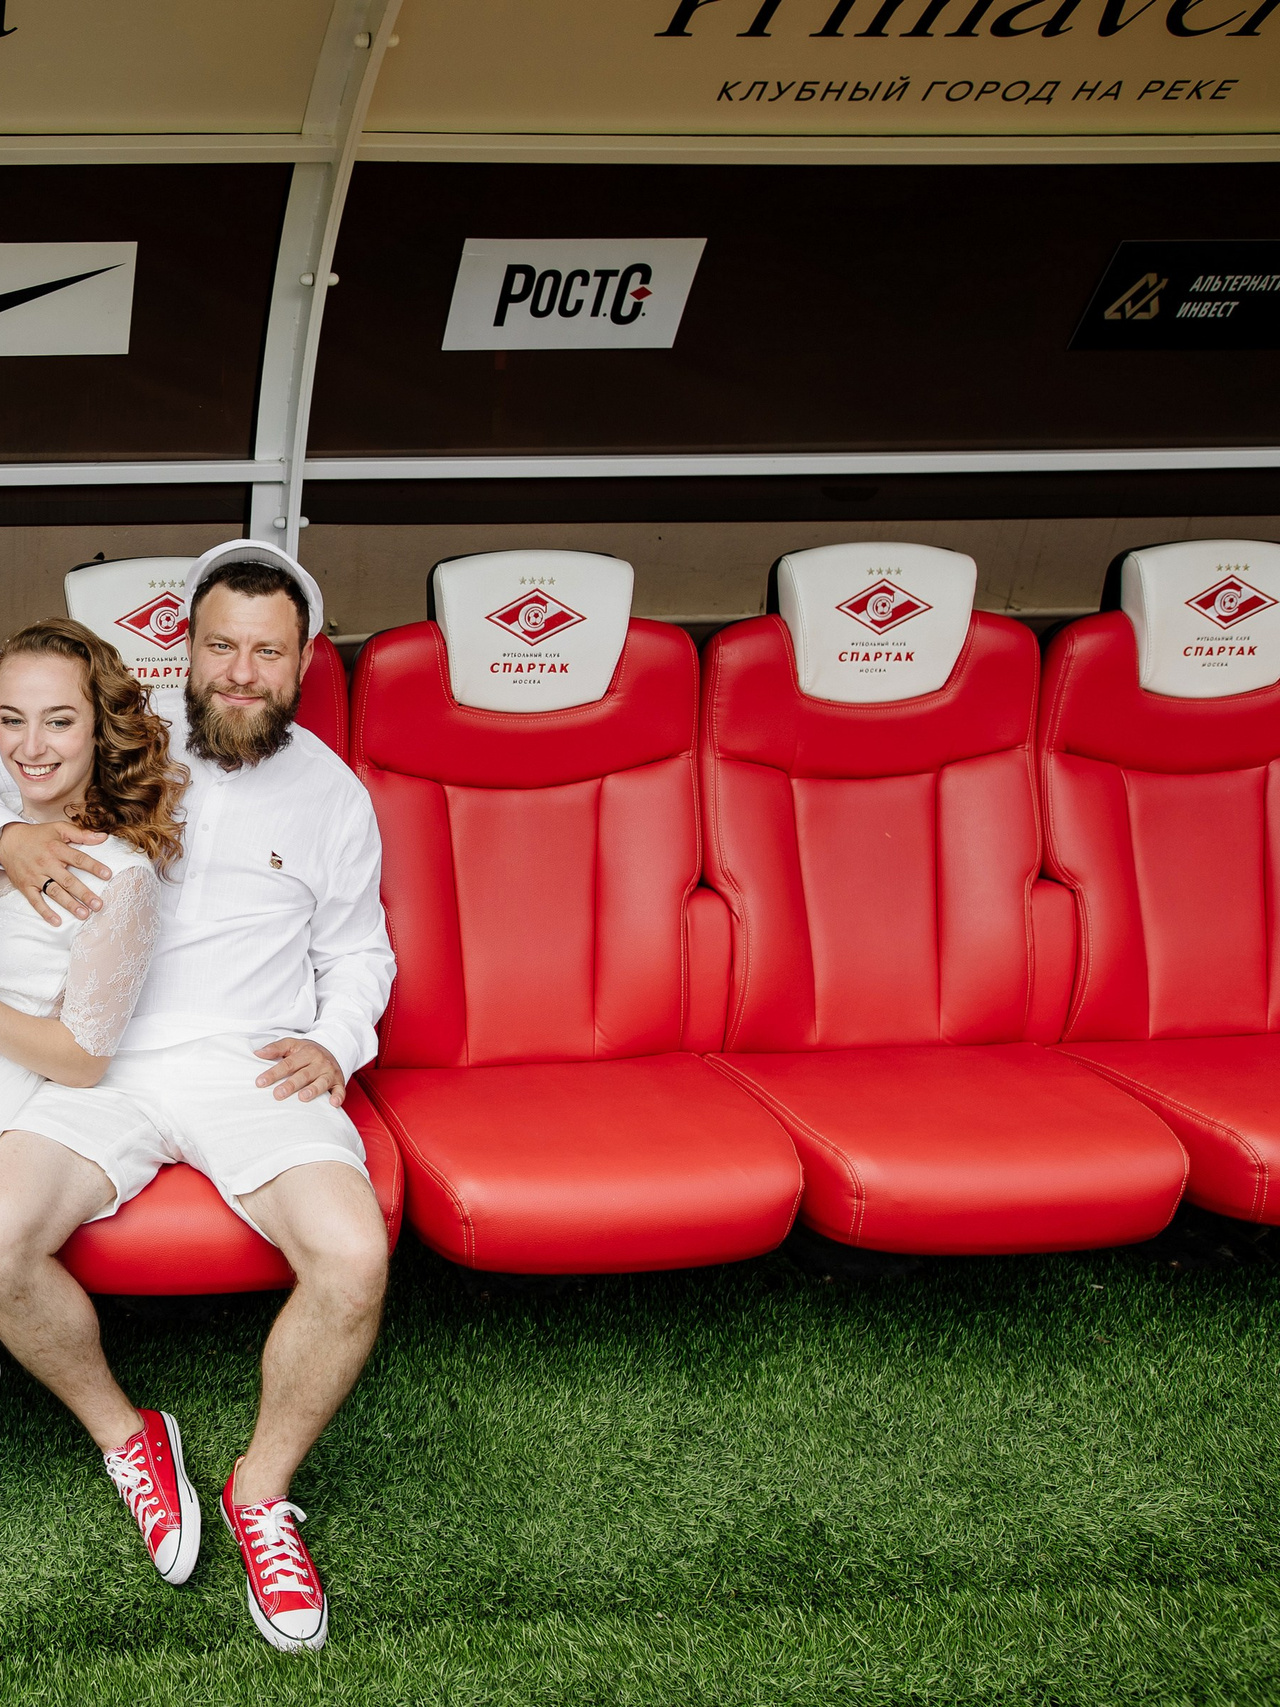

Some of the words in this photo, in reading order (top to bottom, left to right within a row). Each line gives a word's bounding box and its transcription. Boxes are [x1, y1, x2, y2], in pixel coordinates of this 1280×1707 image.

[716, 76, 911, 103] КЛУБНЫЙ
[920, 80, 1063, 106] ГОРОД
[1070, 79, 1122, 102] НА
[1137, 79, 1240, 102] РЕКЕ
[1176, 301, 1240, 318] ИНВЕСТ
[838, 651, 915, 662] СПАРТАК
[1183, 646, 1258, 657] СПАРТАК
[490, 662, 570, 674] СПАРТАК
